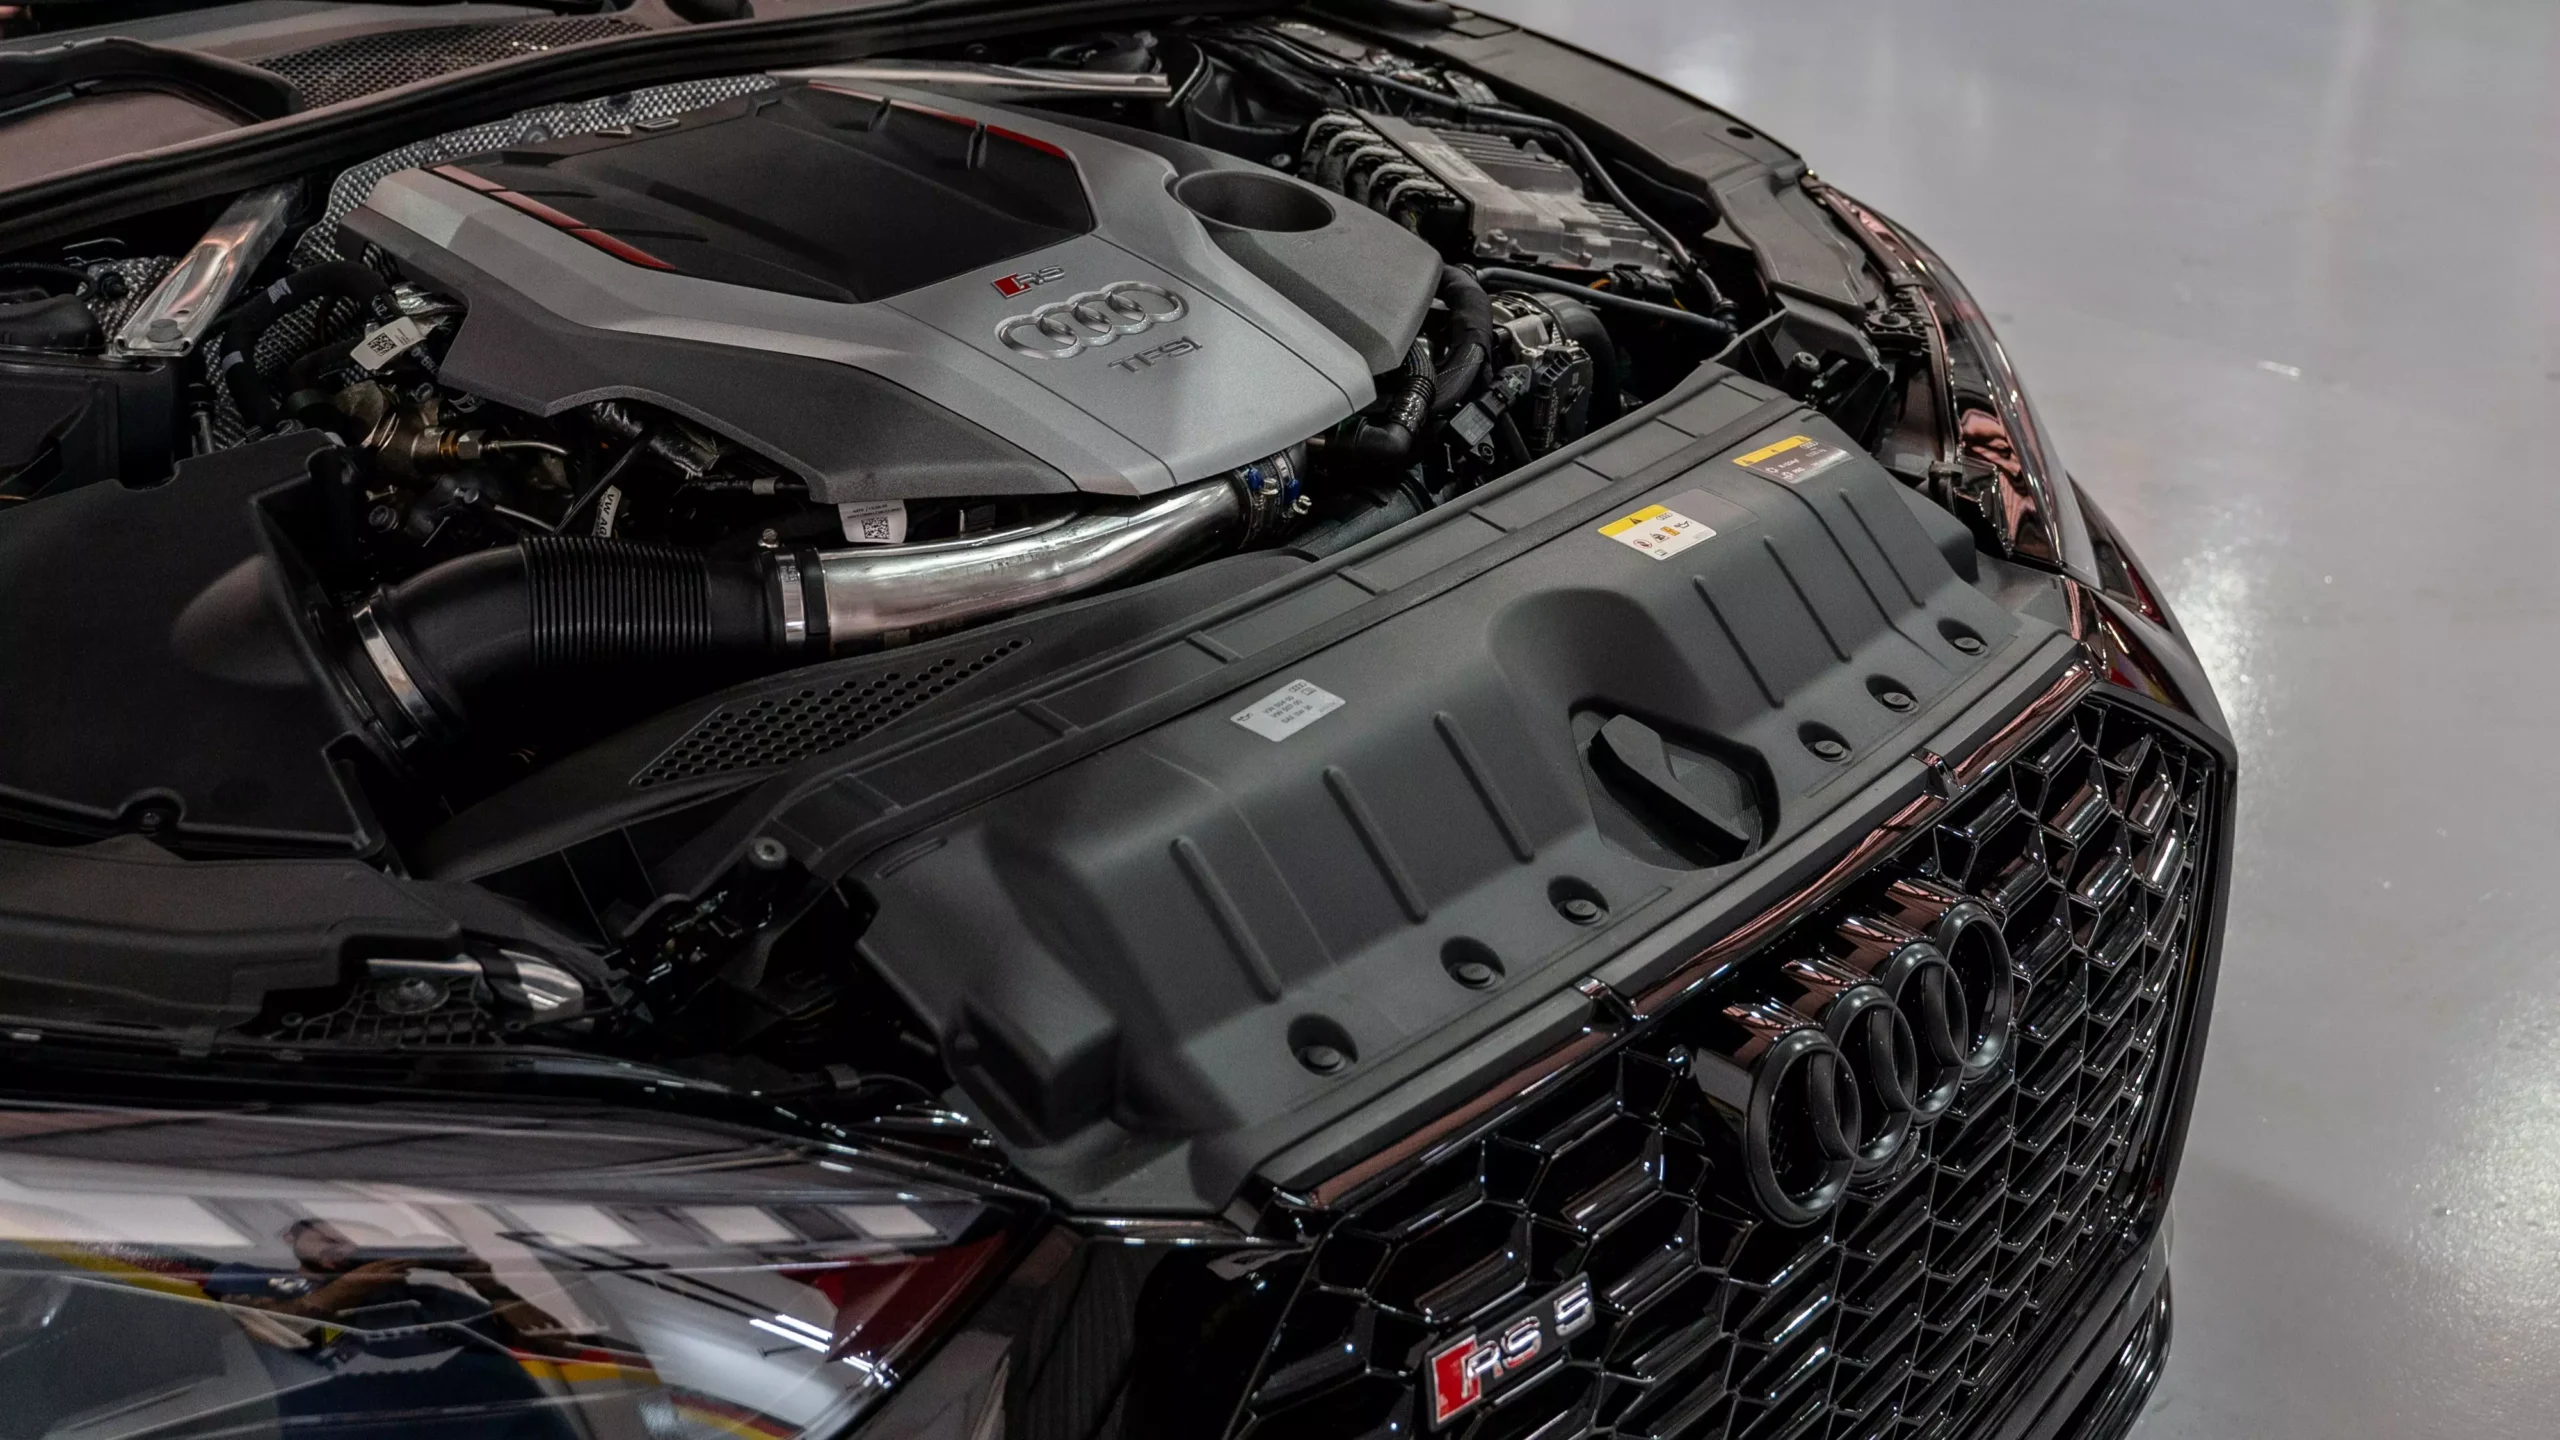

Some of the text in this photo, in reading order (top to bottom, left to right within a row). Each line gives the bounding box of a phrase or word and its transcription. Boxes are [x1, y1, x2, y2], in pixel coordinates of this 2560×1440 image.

[1009, 264, 1066, 290] RS
[1108, 336, 1203, 373] TFSI
[599, 494, 615, 535] VW AG
[1460, 1281, 1593, 1399] RS 5
